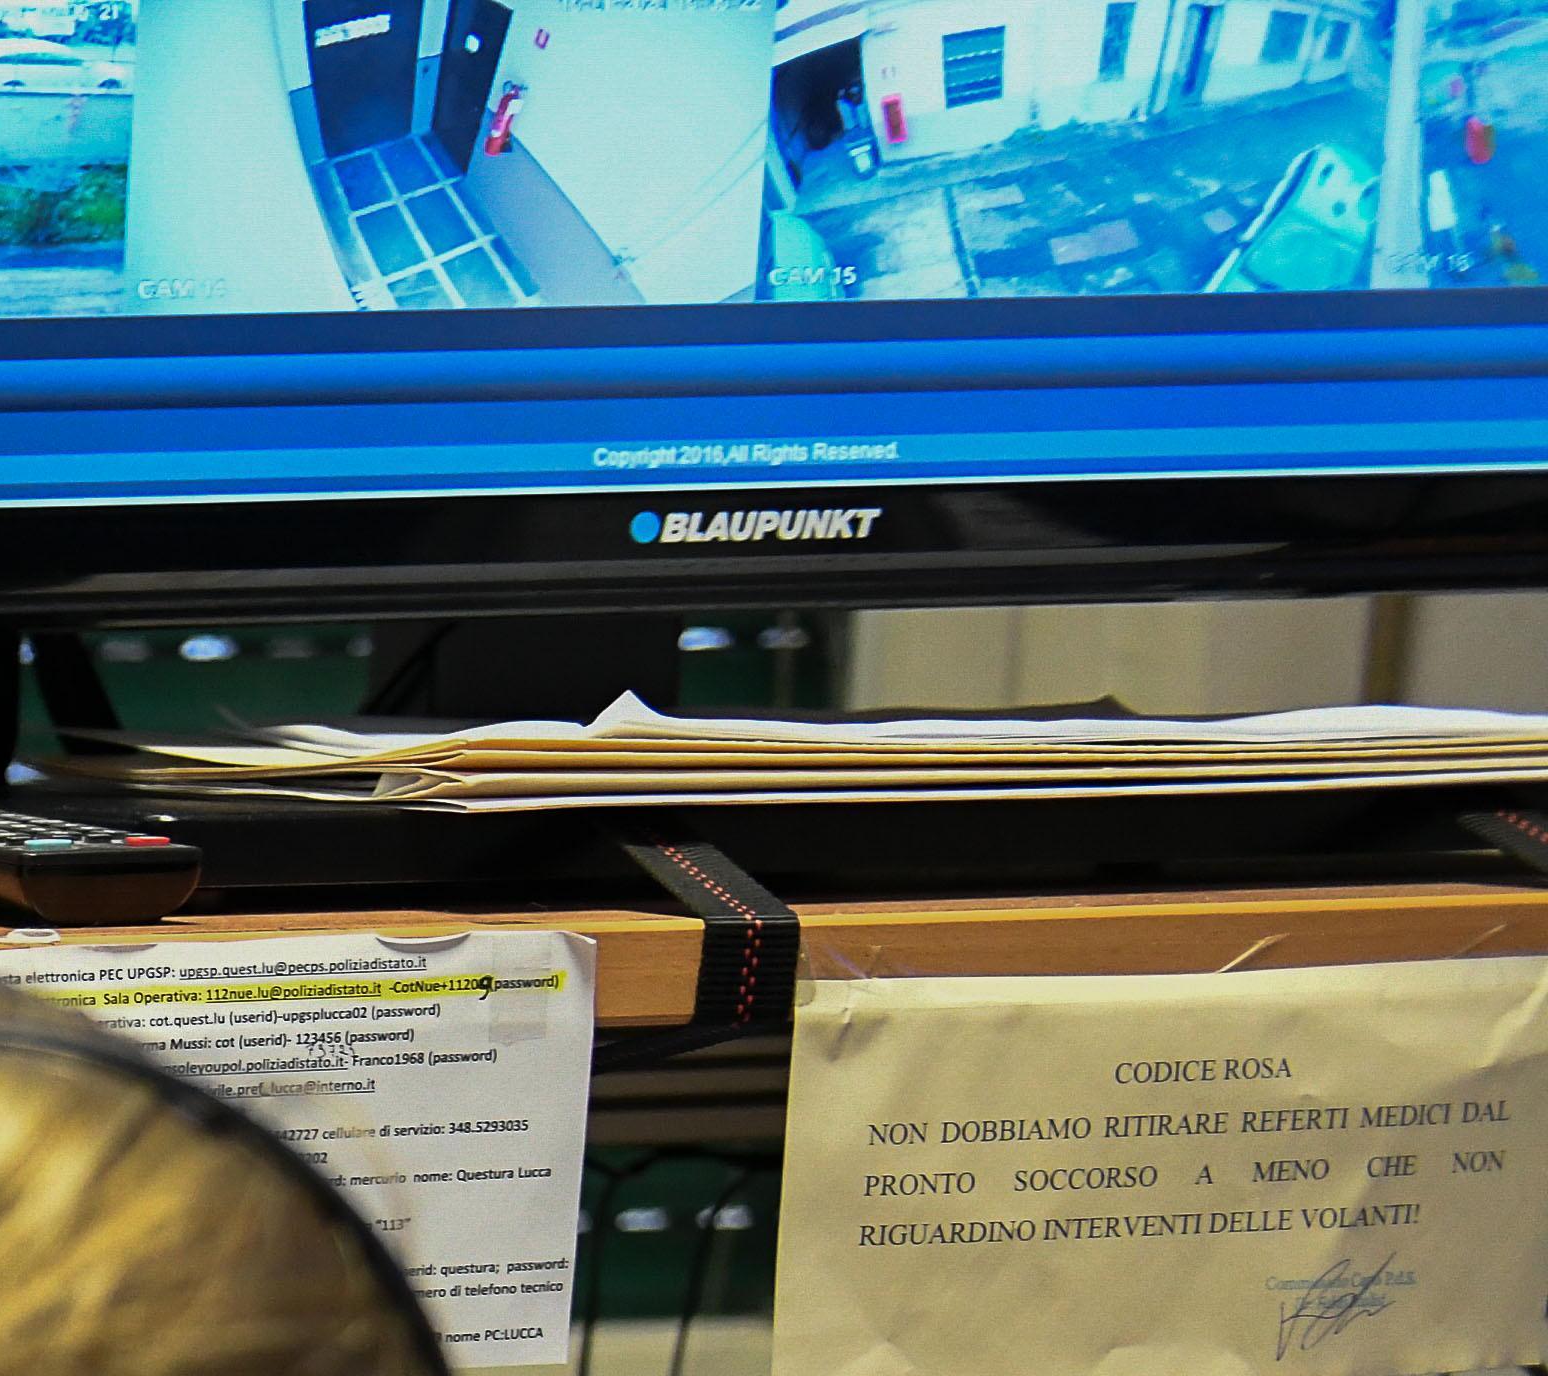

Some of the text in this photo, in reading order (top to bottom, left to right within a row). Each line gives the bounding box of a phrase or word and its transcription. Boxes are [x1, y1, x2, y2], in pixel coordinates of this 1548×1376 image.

[770, 268, 827, 287] CAM
[594, 447, 676, 468] Copyright
[755, 444, 808, 465] Rights
[814, 441, 900, 460] Reserved.
[659, 508, 882, 543] BLAUPUNKT
[26, 970, 95, 983] elettronica
[99, 968, 123, 981] PEC
[127, 966, 175, 980] UPGSP:
[103, 989, 202, 1005] Sala Operativa:
[1115, 1058, 1292, 1084] CODICE ROSA
[379, 1122, 445, 1137] di servizio:
[868, 1100, 1510, 1146] NON DOBBIAMO RITIRARE REFERTI MEDICI DAL
[413, 1166, 552, 1183] nome: Questura Lucca
[864, 1150, 1506, 1196] PRONTO SOCCORSO A MENO CHE NON
[858, 1204, 1420, 1246] RIGUARDINO INTERVENTI DELLE VOLANTI!
[449, 1280, 564, 1297] di telefono tecnico
[445, 1327, 544, 1344] nome PC:LUCCA
